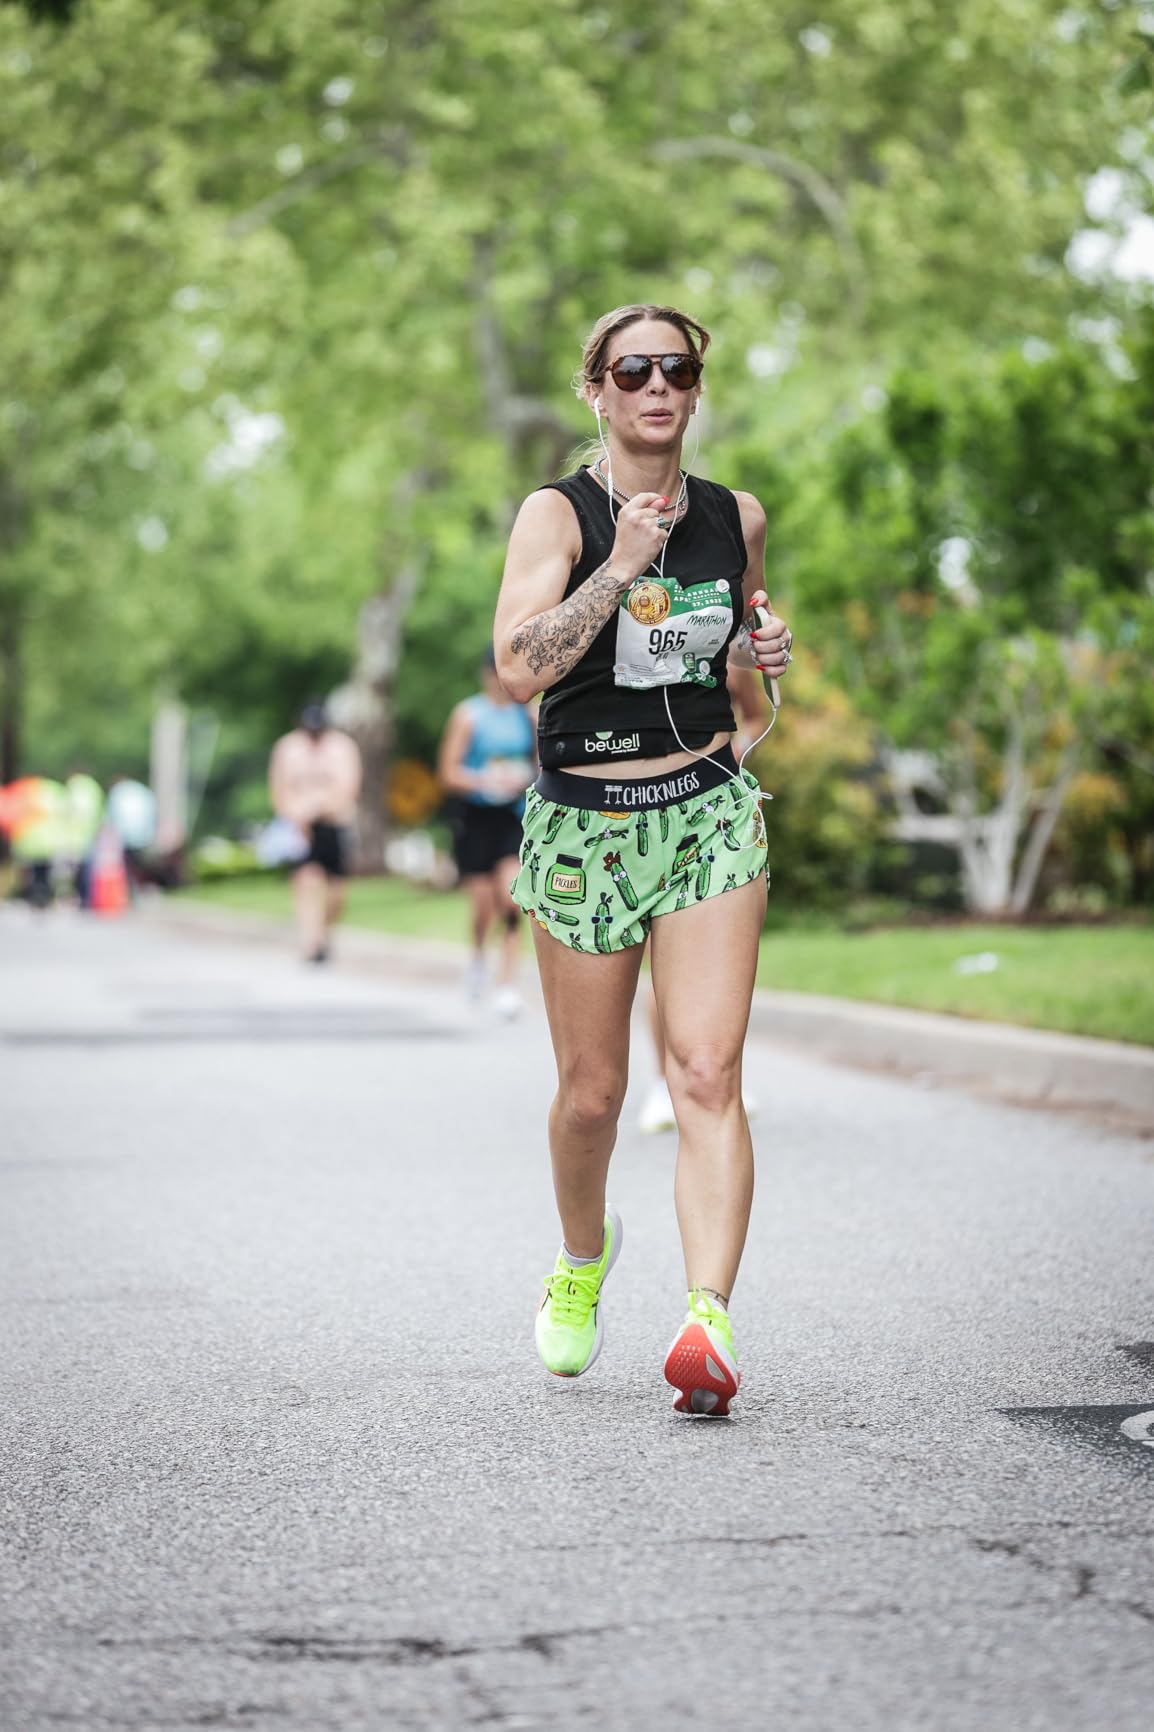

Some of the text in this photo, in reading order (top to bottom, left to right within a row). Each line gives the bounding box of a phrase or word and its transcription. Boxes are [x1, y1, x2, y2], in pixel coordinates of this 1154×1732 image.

[687, 615, 727, 627] MARATHON
[648, 628, 688, 655] 965
[584, 733, 640, 753] bewell
[623, 771, 700, 805] CHICKNLEGS
[554, 876, 577, 888] PICKLES
